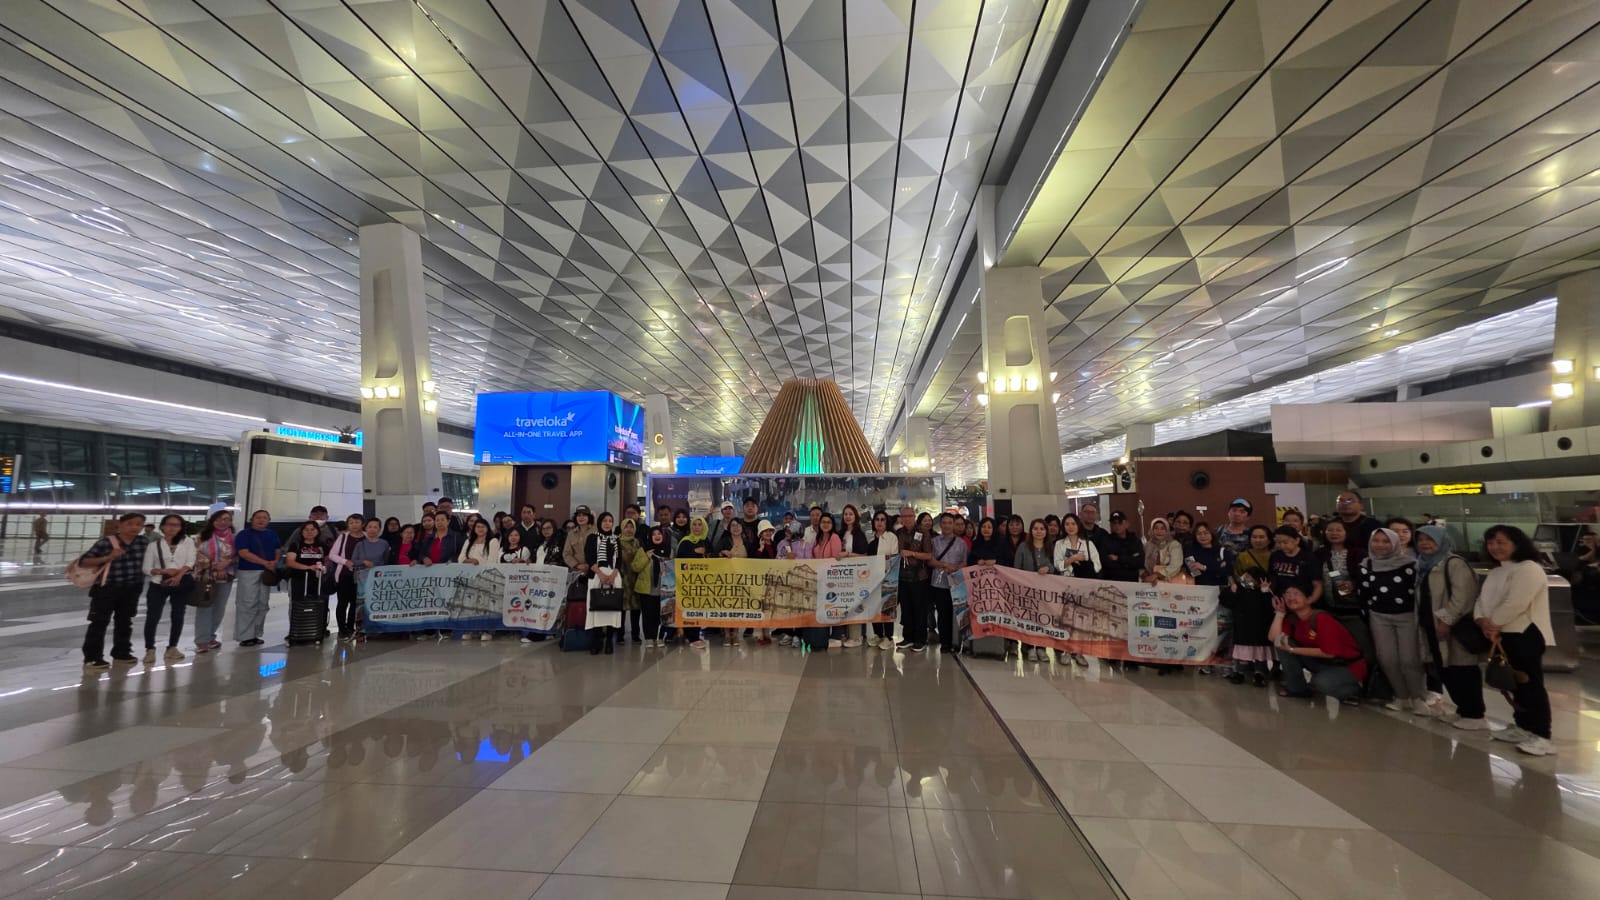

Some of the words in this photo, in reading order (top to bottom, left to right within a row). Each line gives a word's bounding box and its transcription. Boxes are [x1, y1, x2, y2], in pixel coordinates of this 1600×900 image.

[516, 416, 568, 427] traveloka
[654, 433, 664, 446] C
[372, 578, 419, 590] MACAU
[682, 573, 734, 585] MACAU
[736, 574, 790, 586] ZHUHAI
[372, 588, 434, 600] SHENZHEN
[682, 585, 751, 596] SHENZHEN
[972, 578, 1022, 596] MACAU
[1024, 586, 1082, 605] ZHUHAI
[370, 598, 451, 612] GUANGZHOU
[682, 597, 770, 610] GUANGZHOU
[972, 589, 1040, 610] SHENZHEN
[972, 601, 1060, 627] GUANGZHOU
[1026, 624, 1044, 633] SEPT
[1045, 630, 1064, 638] 2025
